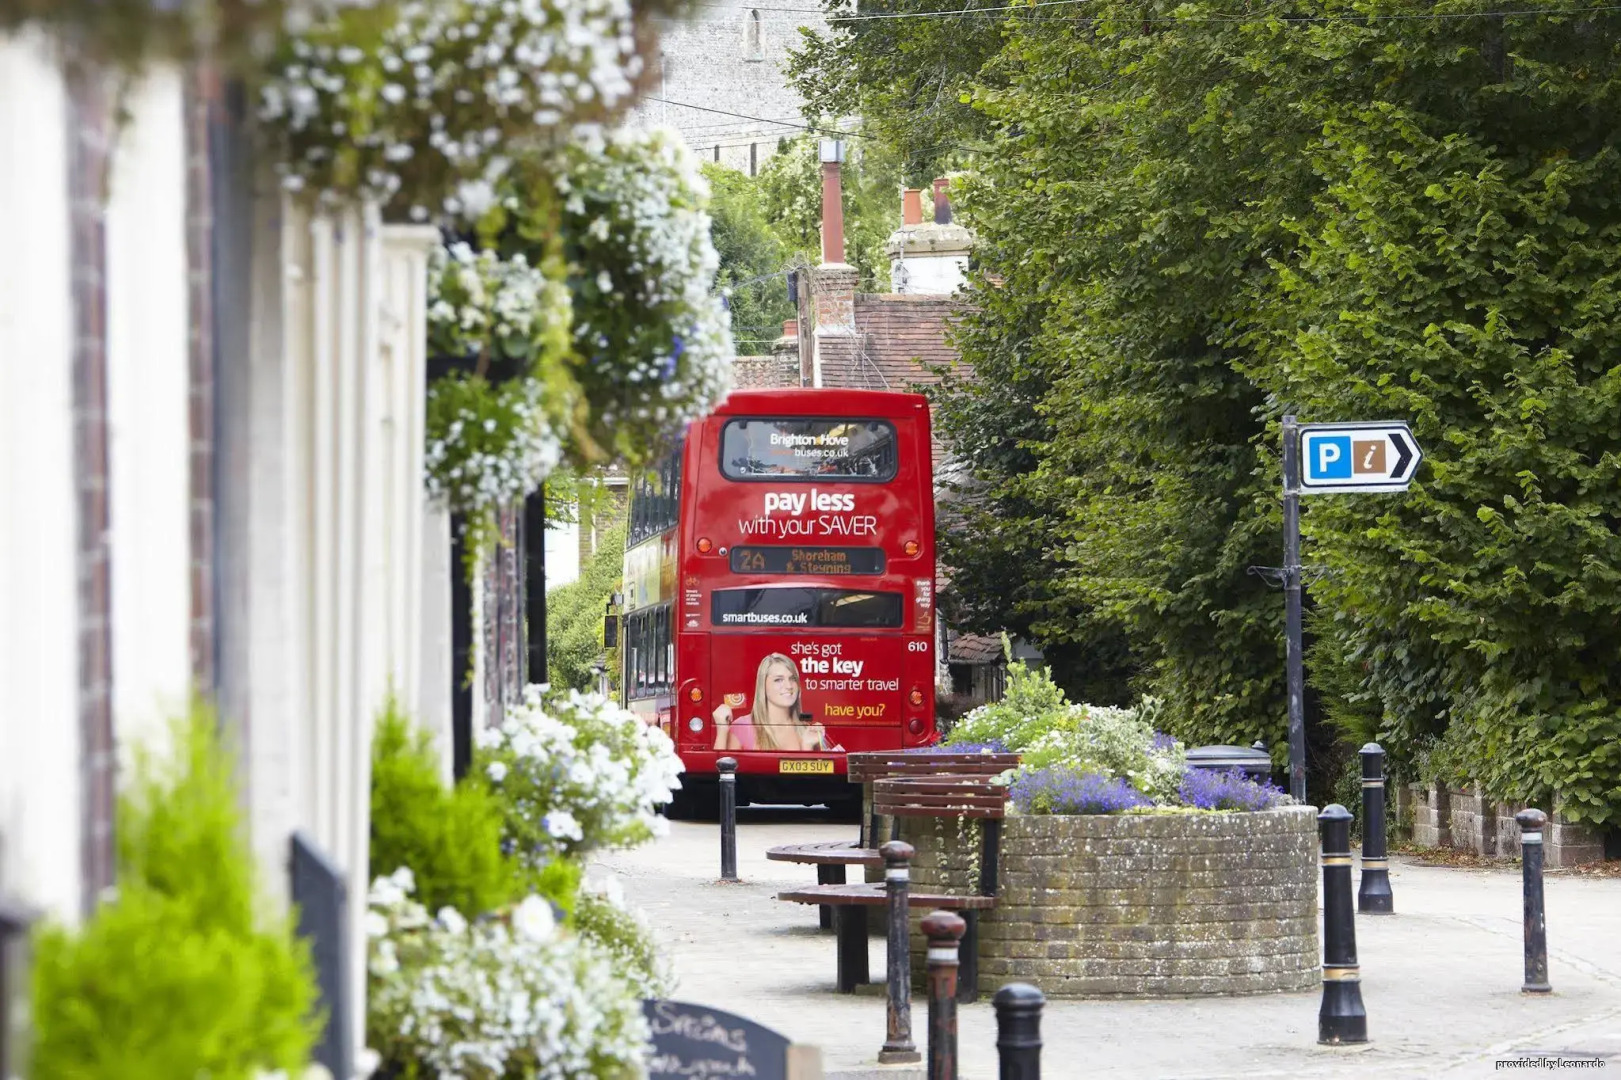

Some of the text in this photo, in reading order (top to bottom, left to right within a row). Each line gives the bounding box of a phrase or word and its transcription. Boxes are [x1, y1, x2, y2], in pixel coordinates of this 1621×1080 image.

[770, 433, 816, 448] Brighton
[820, 434, 849, 446] Hove
[794, 447, 849, 458] buses.co.uk
[1319, 442, 1377, 473] P i
[764, 488, 855, 516] pay less
[739, 515, 877, 539] with your SAVER
[740, 550, 765, 571] 2A
[791, 549, 846, 562] Shoreham
[800, 561, 852, 574] Steyning
[722, 612, 808, 624] smartbuses.co.uk
[791, 641, 842, 657] she's got
[907, 641, 928, 652] 610
[800, 656, 864, 677] the key
[805, 677, 899, 691] to smarter travel
[825, 703, 886, 719] have you?
[782, 761, 829, 771] GX03 SUY
